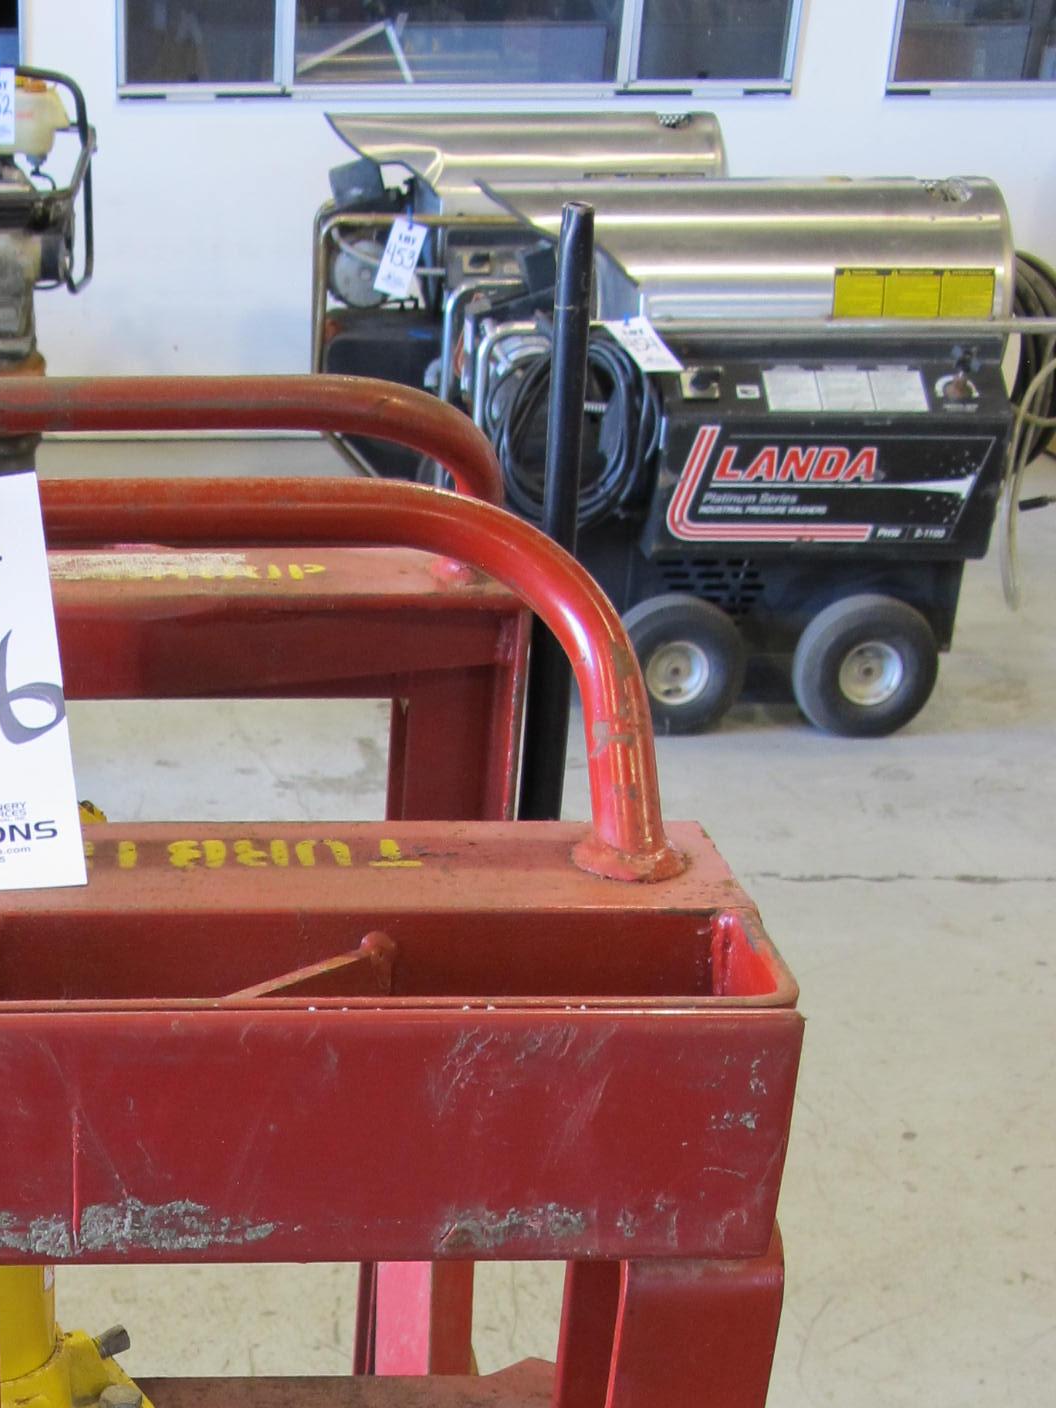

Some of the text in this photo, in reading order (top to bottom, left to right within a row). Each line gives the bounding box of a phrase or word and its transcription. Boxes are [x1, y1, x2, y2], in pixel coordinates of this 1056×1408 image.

[386, 243, 416, 270] 453
[712, 446, 878, 482] LANDA
[702, 491, 799, 504] Platinum Series
[82, 839, 425, 869] TURBI
